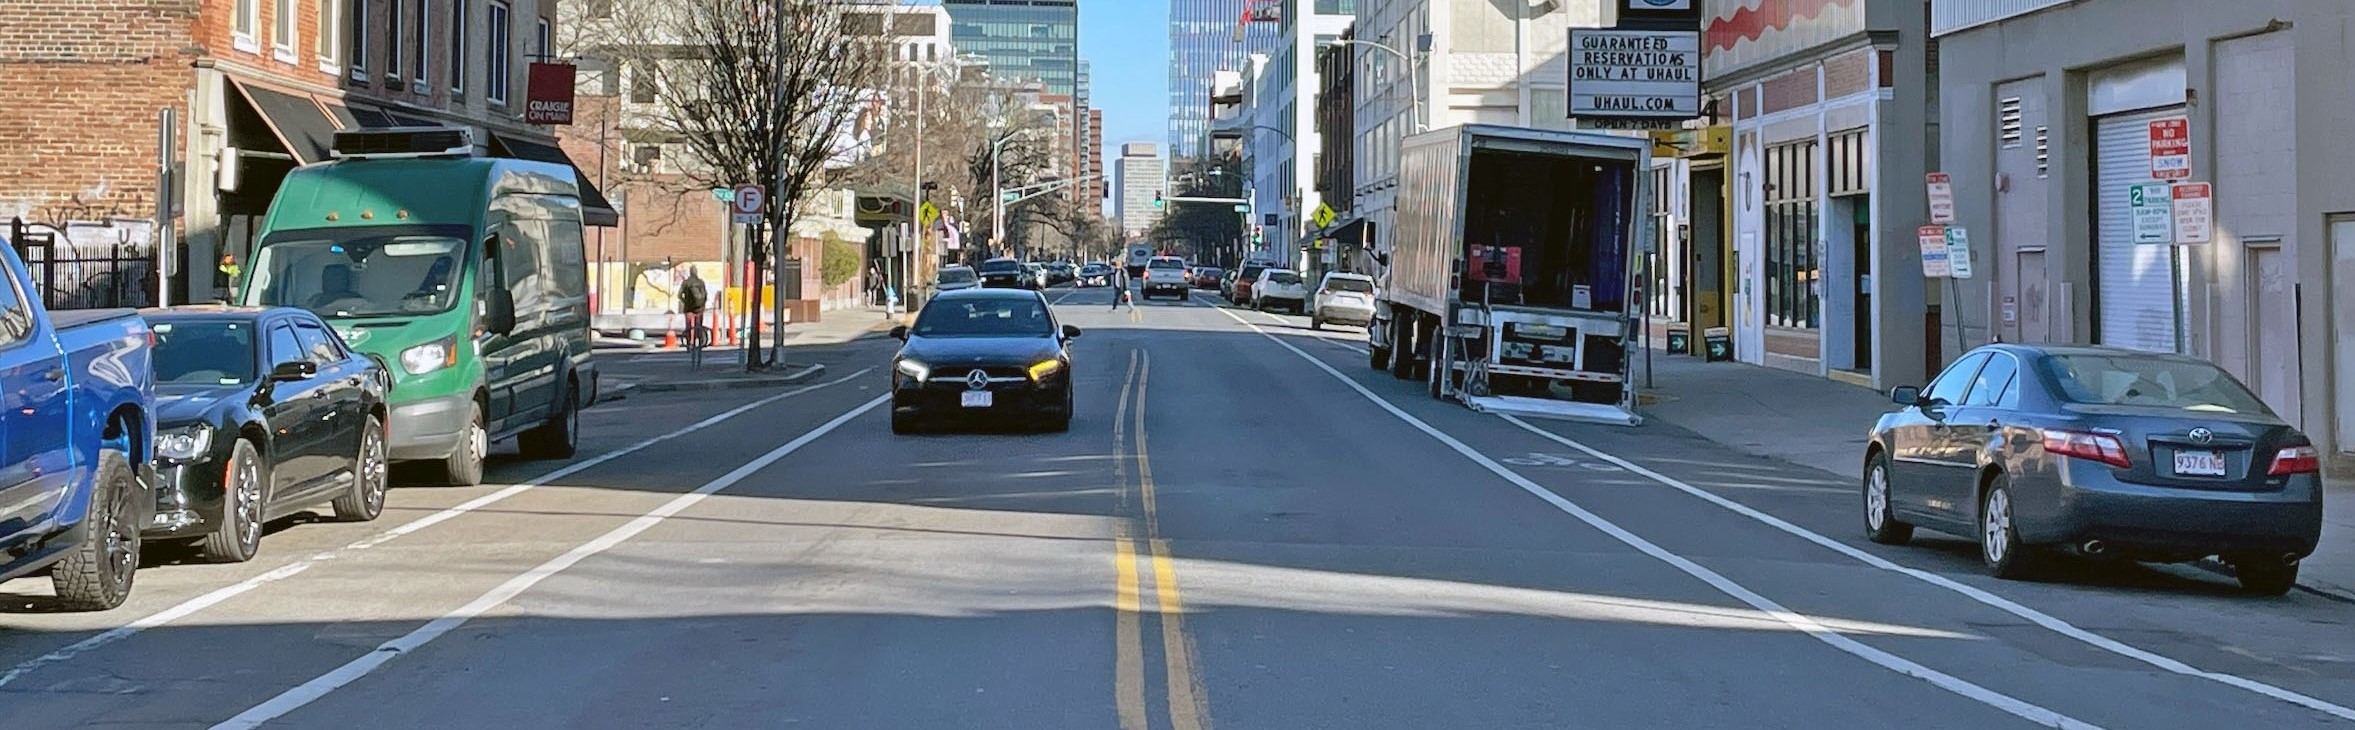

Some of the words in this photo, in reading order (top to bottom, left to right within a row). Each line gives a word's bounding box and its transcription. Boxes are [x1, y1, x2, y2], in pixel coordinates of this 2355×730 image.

[1582, 37, 1668, 50] GUARANTEED
[1584, 52, 1685, 66] RESERVATIONS
[1576, 67, 1612, 79] ONLY
[1621, 68, 1638, 79] AT
[1647, 68, 1691, 80] UHAUL
[530, 101, 569, 112] CRAIGIE
[1594, 96, 1674, 110] UHAUL.COM
[2162, 129, 2175, 138] NO
[2152, 138, 2187, 149] PARKING
[743, 191, 756, 208] F
[2132, 188, 2142, 205] 2
